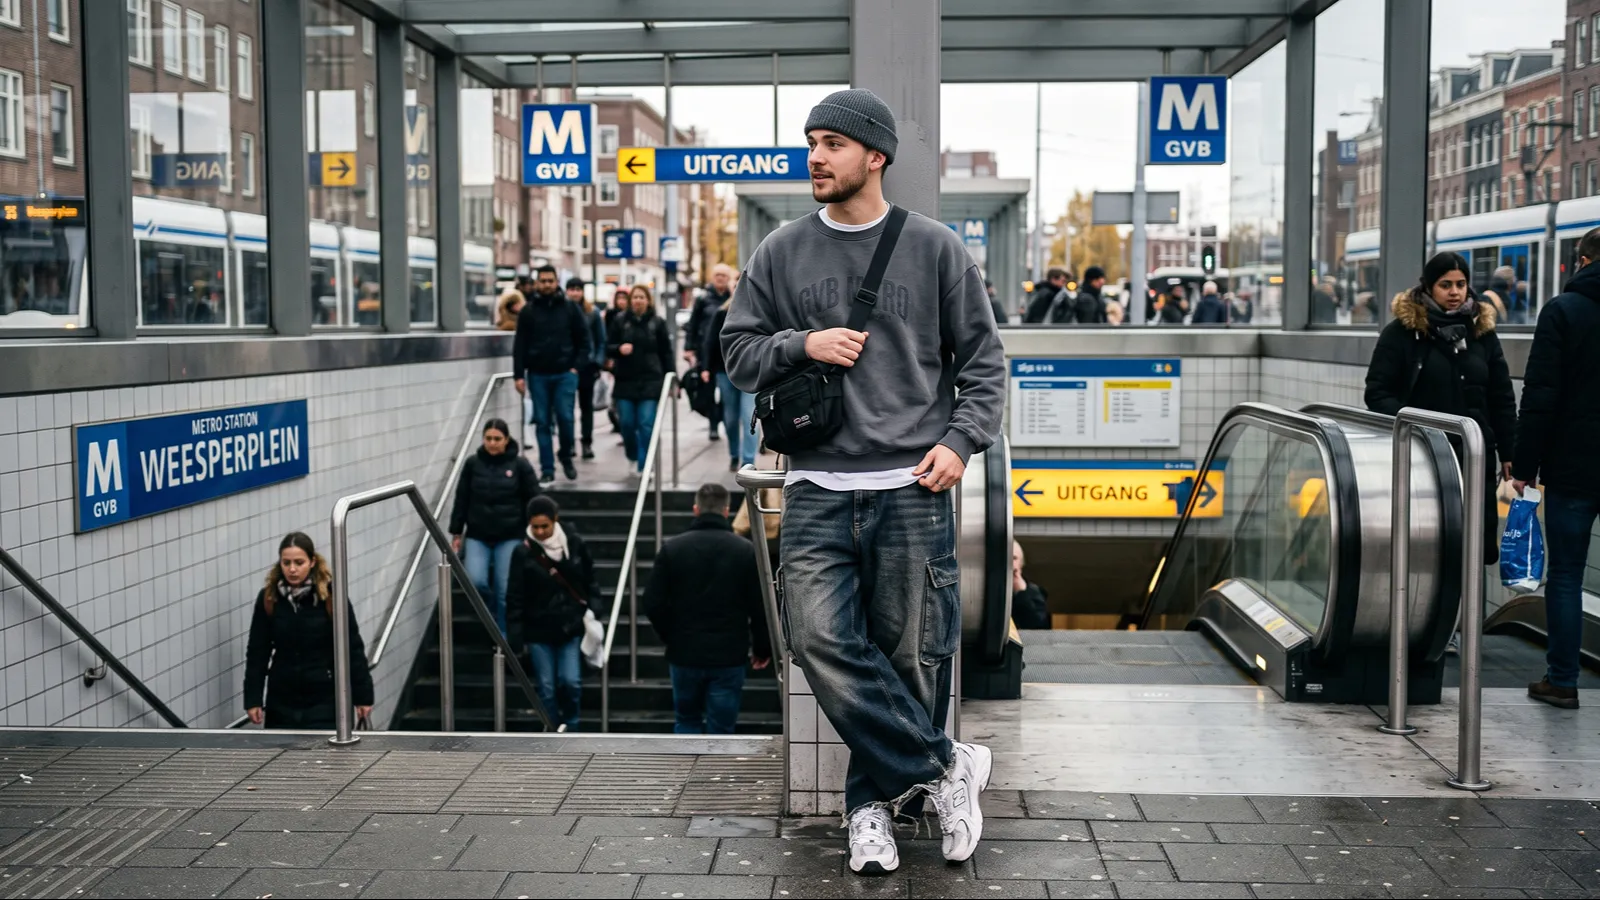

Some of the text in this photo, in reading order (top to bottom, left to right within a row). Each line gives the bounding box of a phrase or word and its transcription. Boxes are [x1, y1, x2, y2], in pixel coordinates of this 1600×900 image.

[1157, 83, 1219, 130] M
[528, 110, 586, 155] M
[1165, 140, 1211, 157] GVB
[536, 162, 580, 179] GVB
[684, 154, 789, 175] UITGANG
[799, 277, 839, 320] GVB
[192, 411, 258, 435] METRO STATION
[85, 439, 123, 497] M
[140, 425, 299, 493] WEESPERPLEIN
[1057, 485, 1148, 501] UITGANG
[93, 499, 118, 518] GVB
